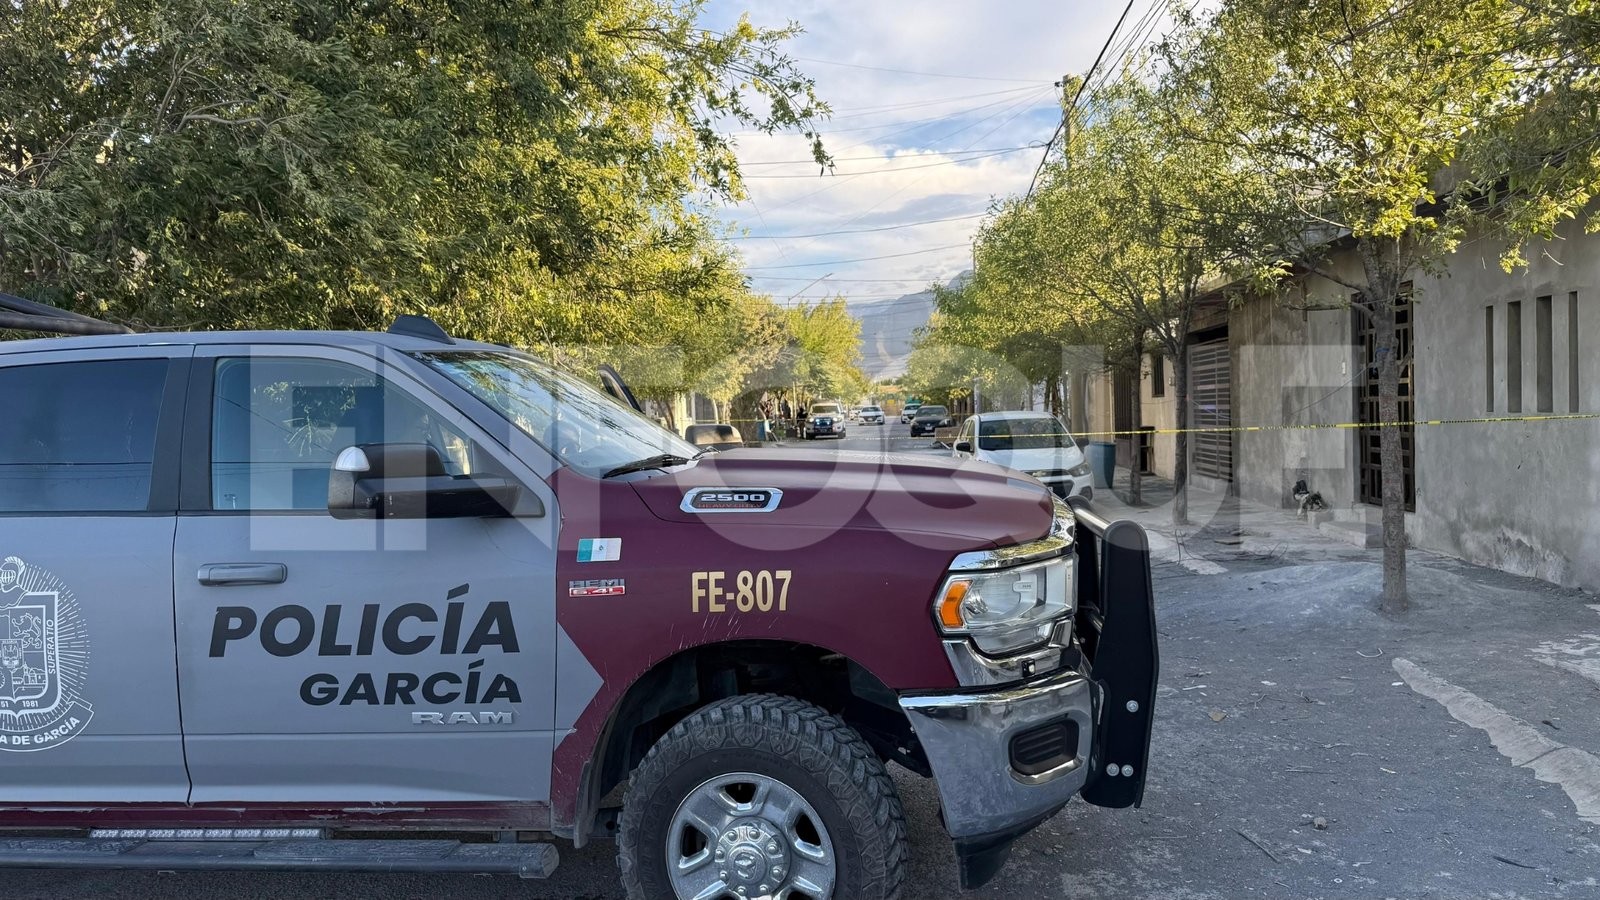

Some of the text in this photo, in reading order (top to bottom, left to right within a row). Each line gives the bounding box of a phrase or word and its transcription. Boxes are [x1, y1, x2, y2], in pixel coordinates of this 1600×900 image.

[701, 493, 765, 502] 2500
[569, 578, 625, 588] HEMI
[691, 570, 792, 612] FE-807
[209, 583, 520, 657] POLICÍA
[46, 619, 56, 675] SUPERATIO
[300, 658, 522, 706] GARCÍA
[22, 700, 39, 708] 1981
[411, 711, 513, 726] RAM
[12, 735, 31, 745] DE
[33, 716, 81, 744] GARCÍA
